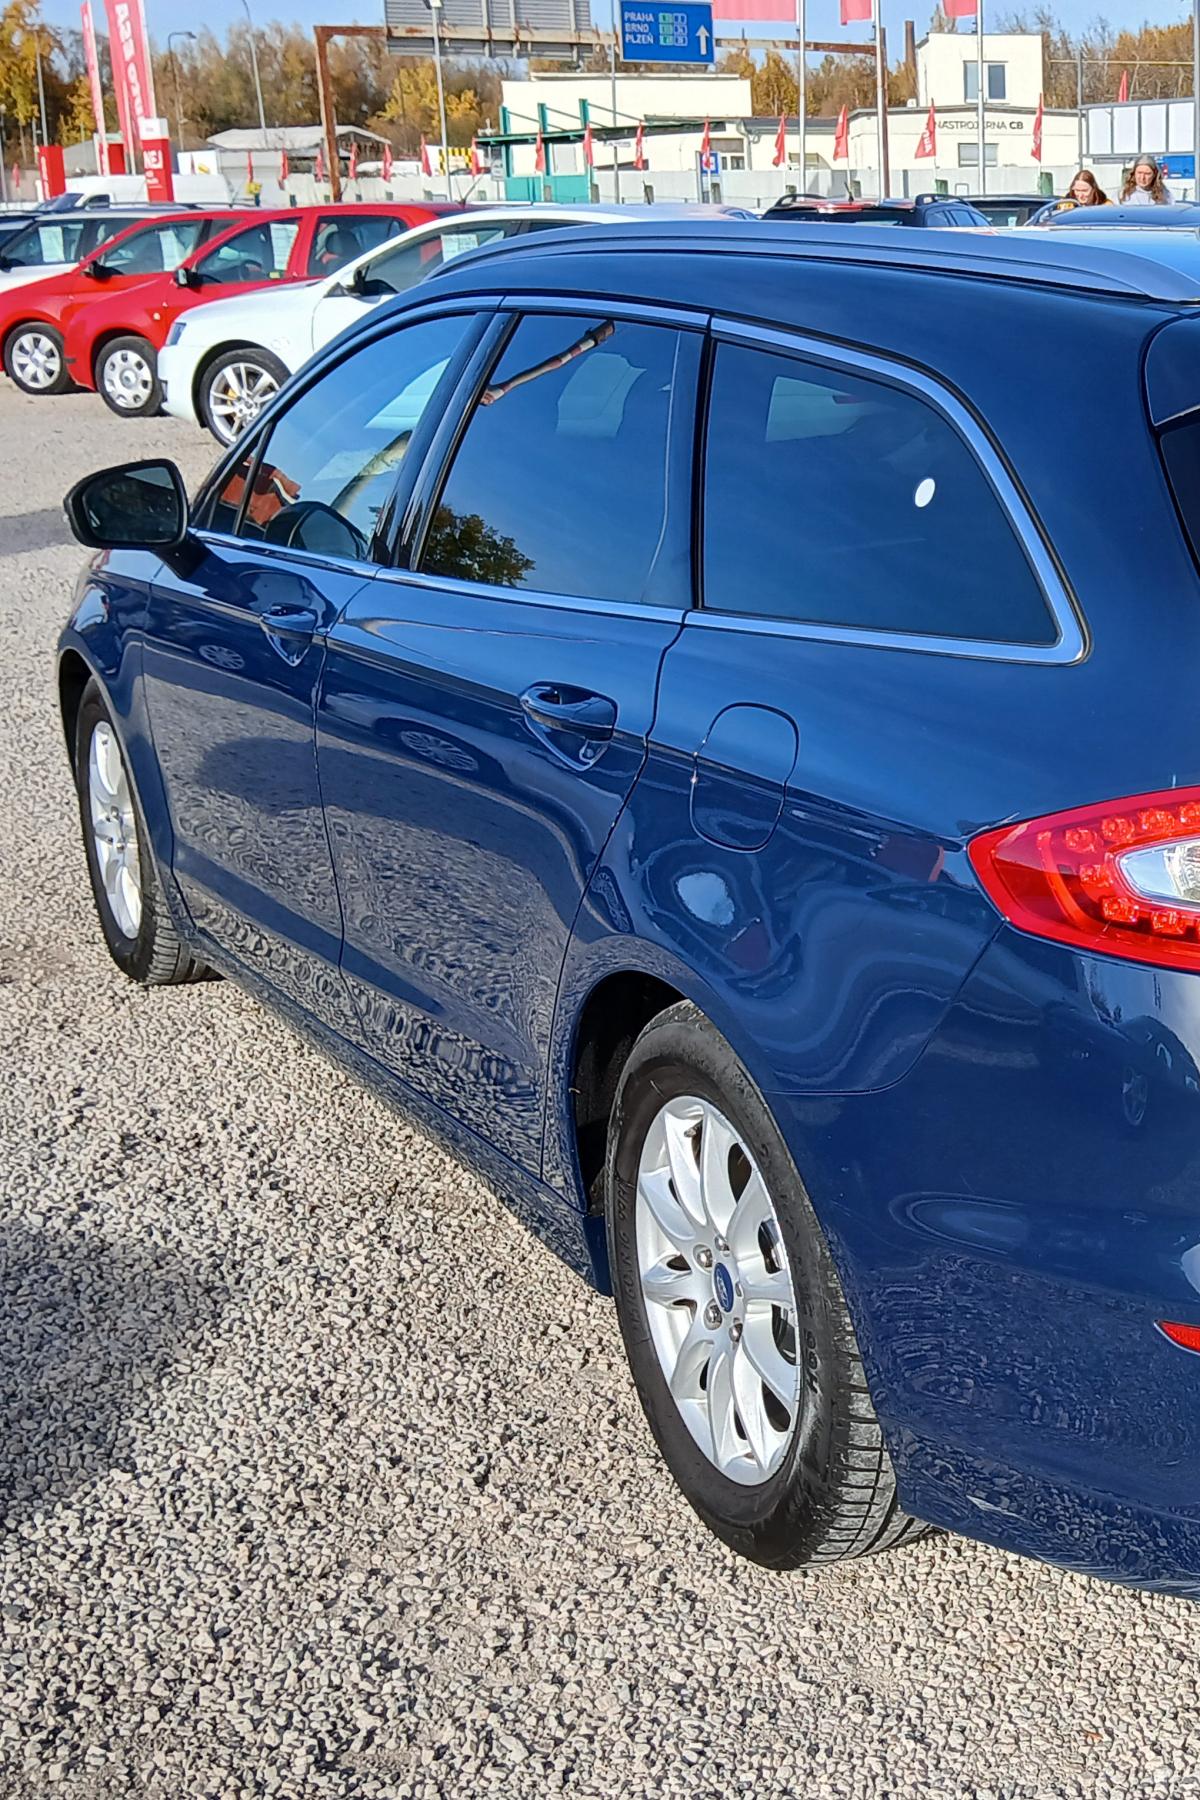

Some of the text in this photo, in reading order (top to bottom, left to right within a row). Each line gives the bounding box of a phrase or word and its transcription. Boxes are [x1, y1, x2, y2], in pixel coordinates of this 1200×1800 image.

[624, 11, 654, 22] PRAHA
[625, 22, 649, 33] BRNO
[1009, 120, 1024, 130] CB
